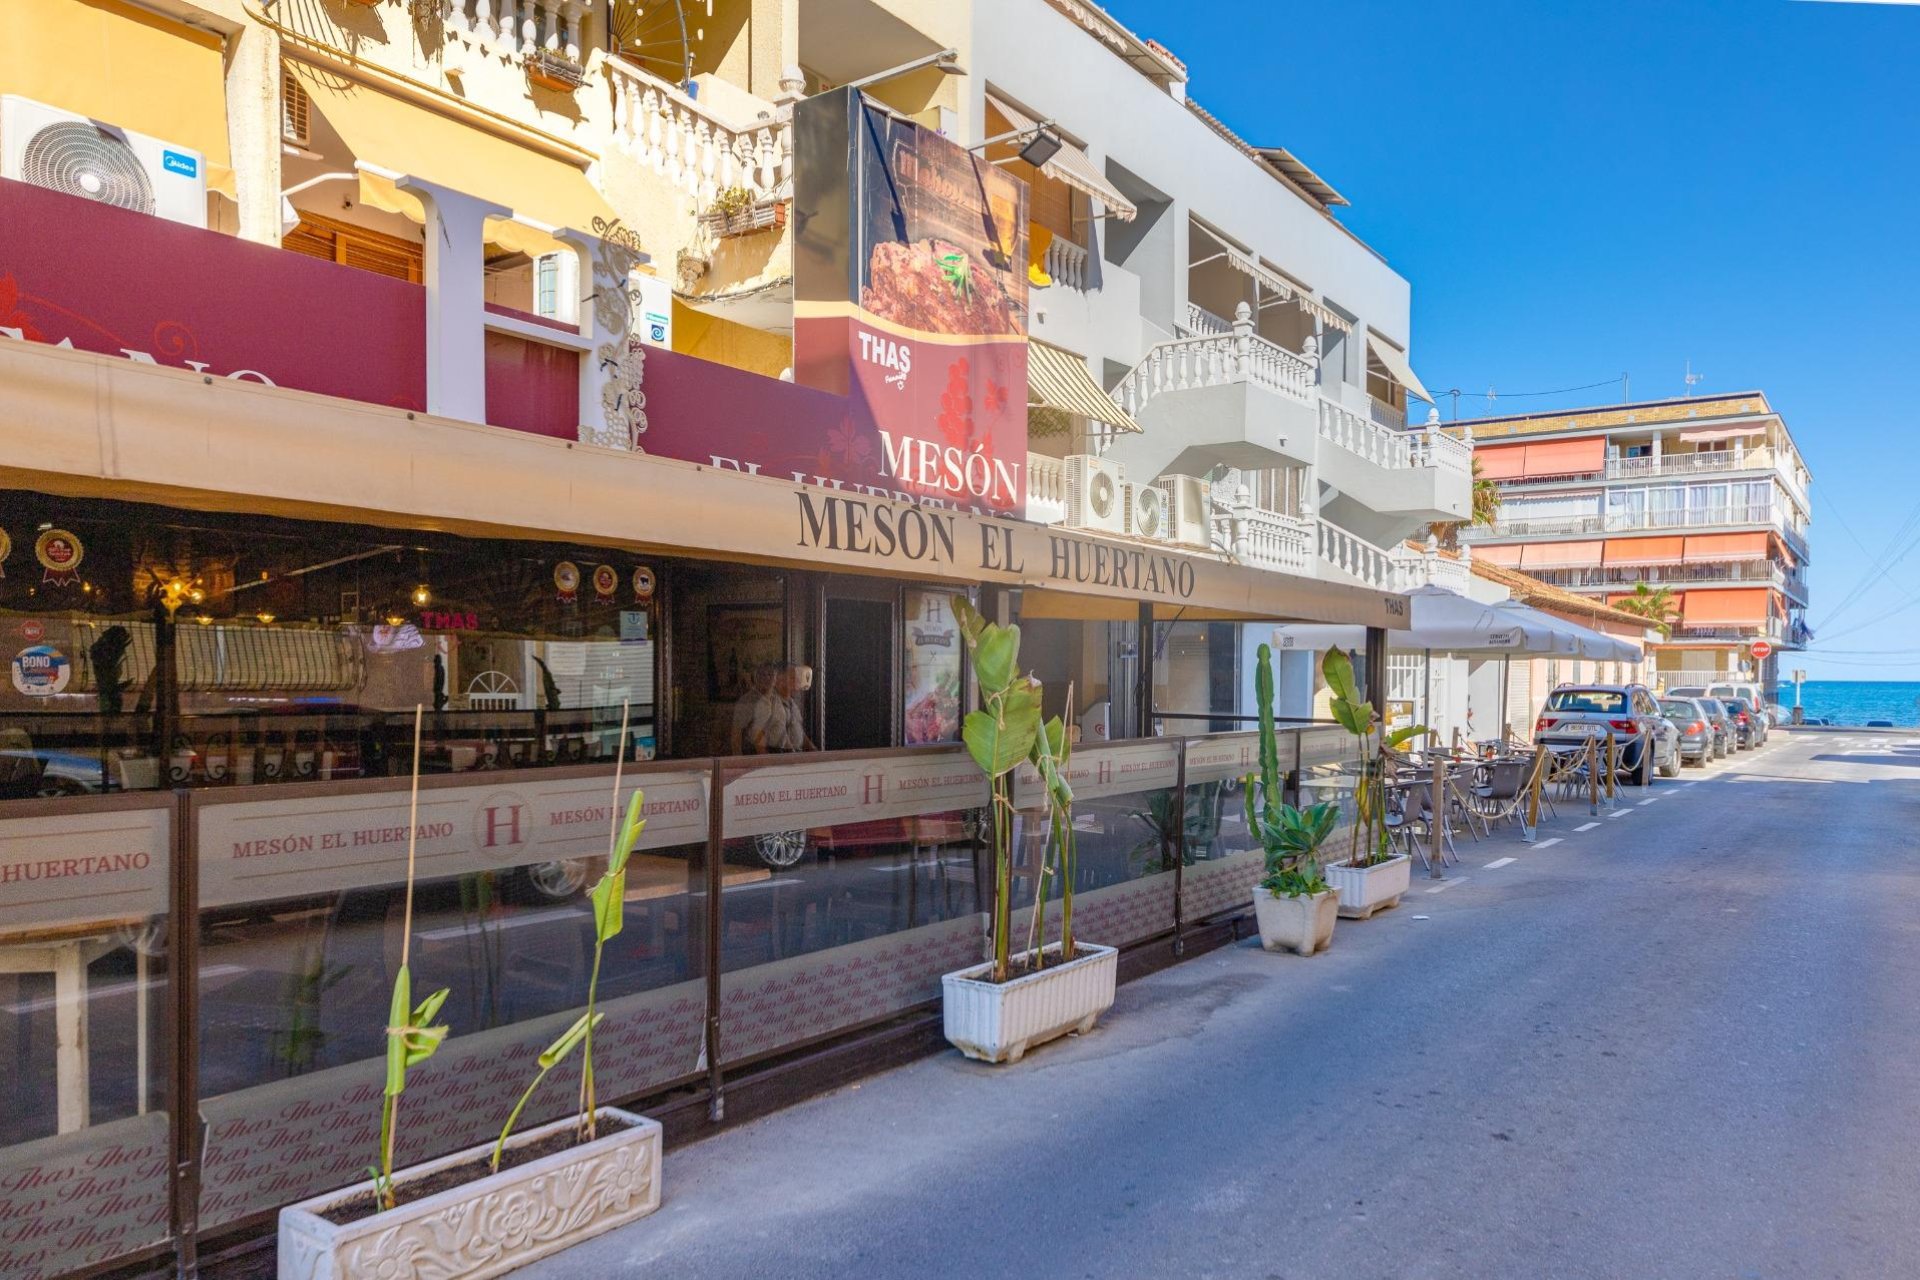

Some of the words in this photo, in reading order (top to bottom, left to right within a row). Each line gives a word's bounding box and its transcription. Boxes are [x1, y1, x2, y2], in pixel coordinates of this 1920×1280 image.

[858, 330, 912, 374] THAS
[877, 430, 1020, 504] MESÓN
[795, 491, 955, 565] MESÓN
[978, 522, 1025, 574] EL
[1049, 535, 1196, 599] HUERTANO
[1385, 598, 1404, 616] THAS
[22, 656, 51, 668] BONO
[899, 775, 931, 791] MESÓN
[931, 776, 943, 788] EL
[943, 773, 986, 786] HUERTANO
[1098, 760, 1112, 785] H
[734, 786, 776, 807] MESÓN
[778, 788, 795, 801] EL
[796, 784, 848, 800] HUERTANO
[863, 774, 884, 805] H
[482, 803, 525, 848] H
[550, 806, 606, 826] MESÓN
[640, 798, 701, 817] UERTANO
[232, 834, 315, 859] MESÓN
[320, 832, 348, 851] EL
[2, 852, 150, 883] HUERTANO
[2, 1165, 76, 1196] Thas
[85, 1144, 154, 1172] Thas
[0, 1200, 47, 1221] has
